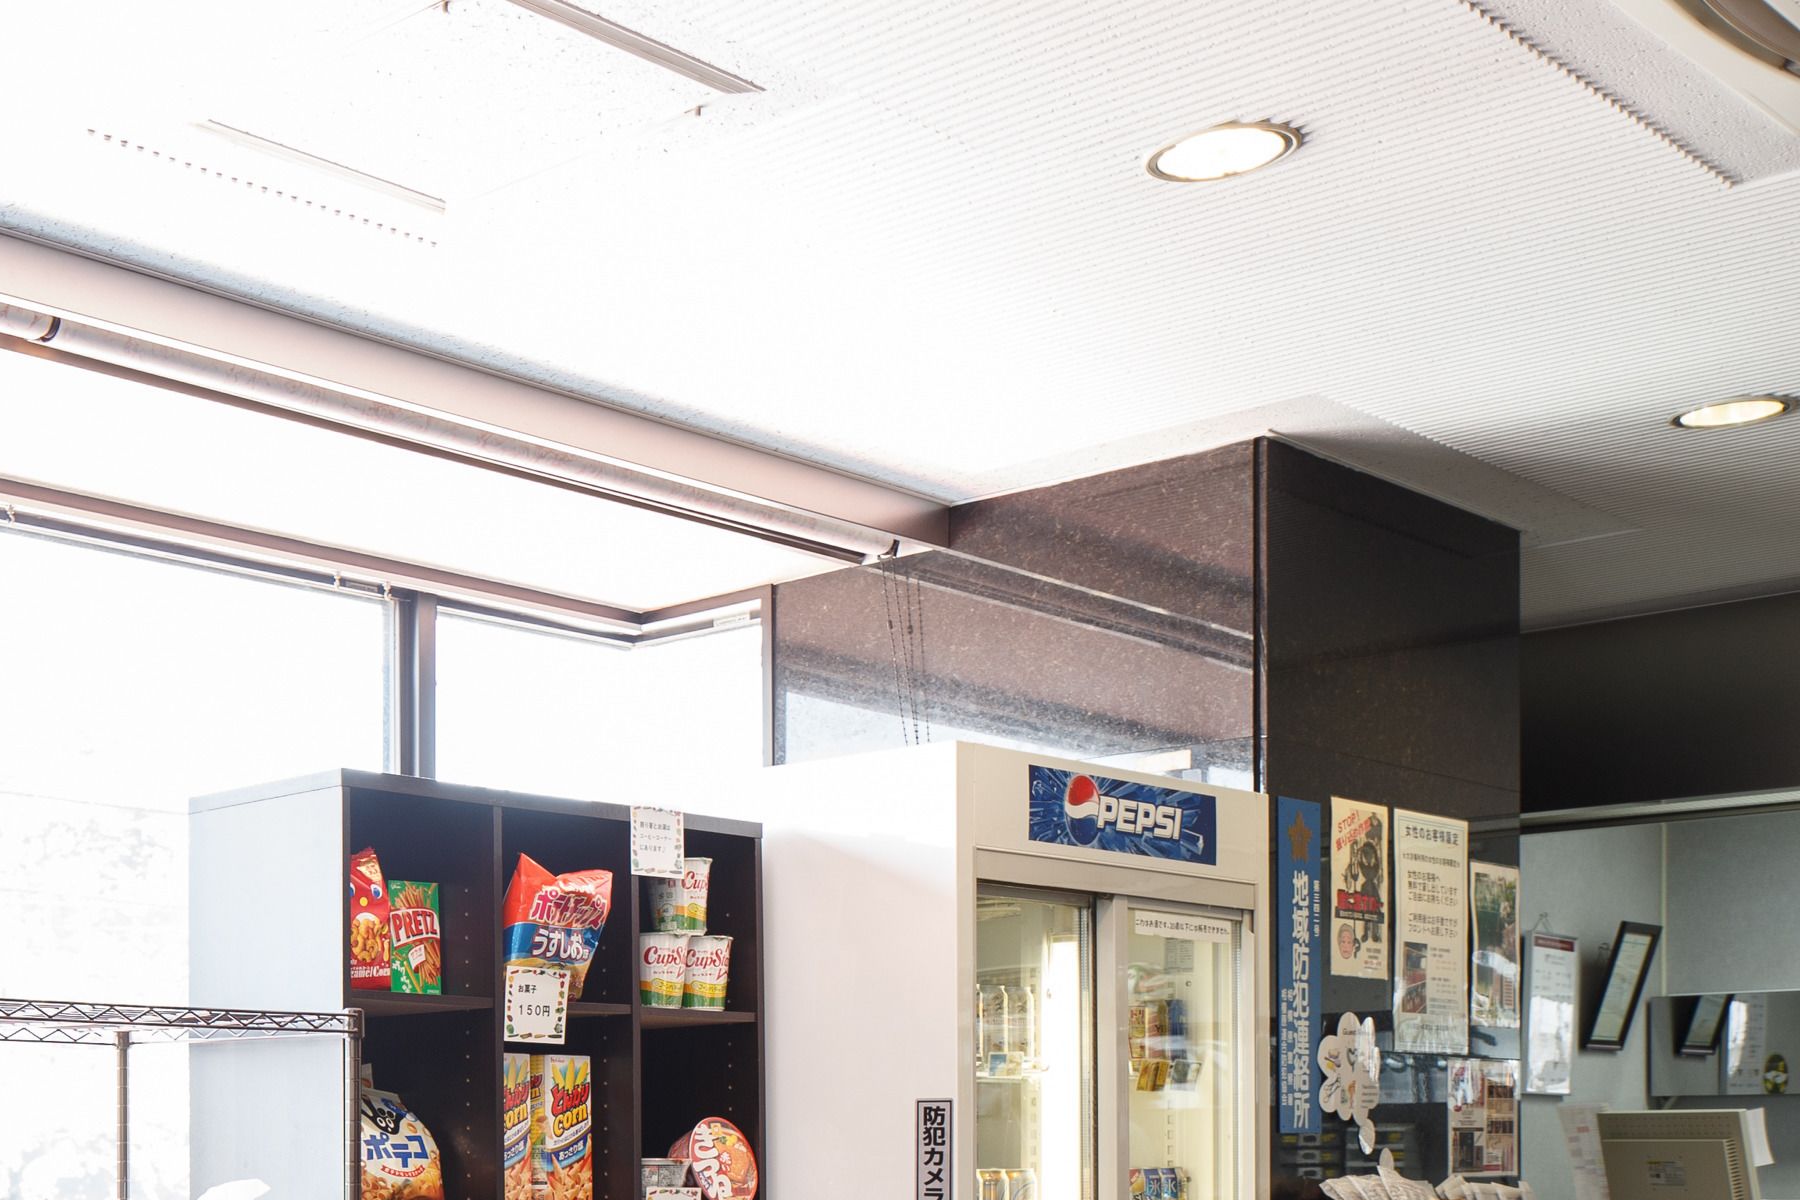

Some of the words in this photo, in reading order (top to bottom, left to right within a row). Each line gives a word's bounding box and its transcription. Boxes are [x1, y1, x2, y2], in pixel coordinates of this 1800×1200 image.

[1096, 795, 1184, 840] PEPSI
[530, 886, 607, 929] ポテトチップス
[391, 910, 438, 942] PRETZ
[518, 984, 537, 994] お菓子
[1292, 870, 1310, 1129] 地域防犯連絡所
[518, 1004, 551, 1017] 150円
[551, 1082, 590, 1116] とんがり
[553, 1103, 588, 1137] corn
[363, 1132, 429, 1168] ポテコ
[558, 1139, 584, 1161] あっさり塩
